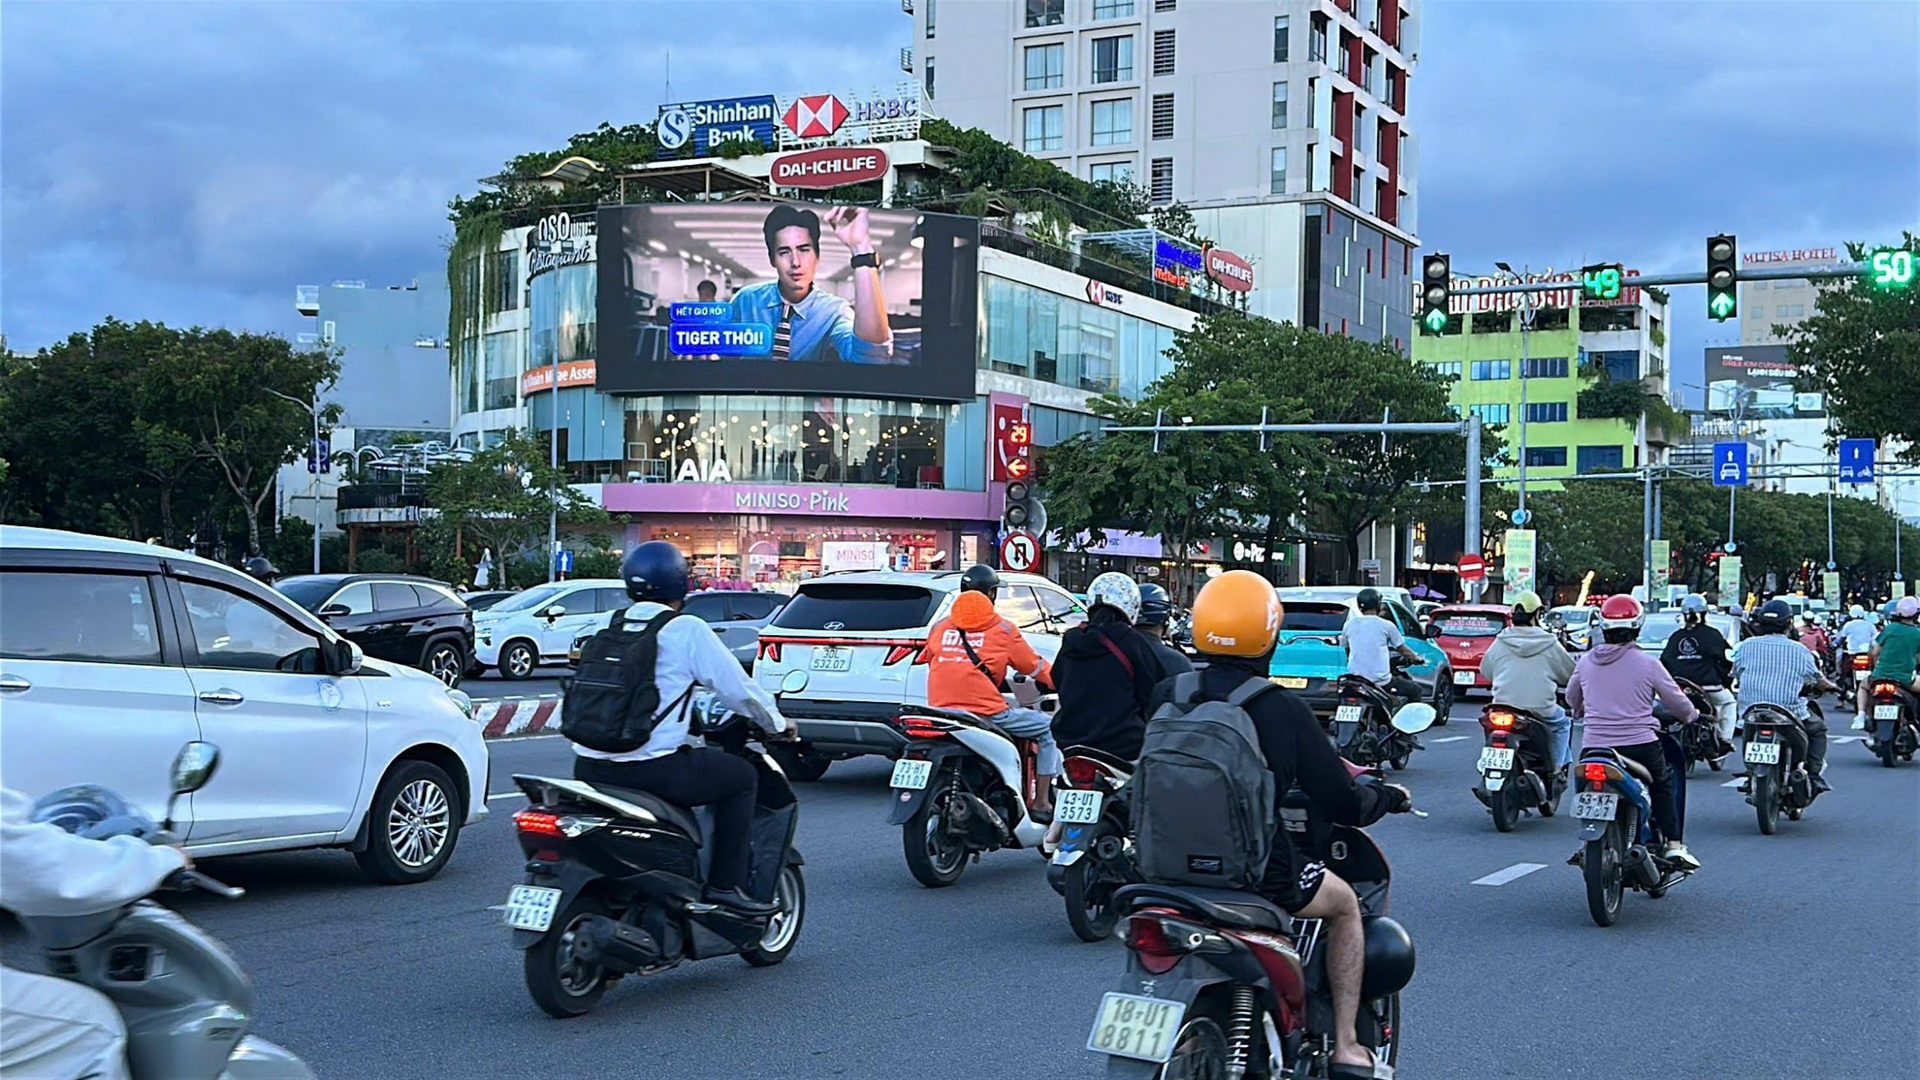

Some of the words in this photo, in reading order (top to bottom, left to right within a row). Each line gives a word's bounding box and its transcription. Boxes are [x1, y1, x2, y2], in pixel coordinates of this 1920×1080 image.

[693, 103, 771, 124] Shinhan
[854, 99, 917, 121] HSBC
[708, 128, 756, 147] Bank
[779, 159, 842, 178] DAI-ICHI
[842, 155, 877, 170] LIFE
[1742, 251, 1790, 264] MITISA
[1792, 248, 1838, 260] HOTEL
[1873, 250, 1912, 283] 50
[1584, 268, 1620, 299] 49
[676, 331, 720, 346] TIGER
[723, 328, 764, 346] THÔI!
[1011, 425, 1027, 443] 29
[677, 458, 732, 482] AIA
[736, 492, 801, 509] MINISO
[809, 489, 850, 512] Pink
[836, 549, 875, 562] MINISO
[823, 649, 840, 659] 30L
[813, 659, 846, 669] 532.07
[900, 762, 925, 775] 73-H1
[1063, 792, 1094, 806] 43-U1
[1060, 806, 1092, 821] 3573
[1112, 998, 1170, 1030] 18-U1
[1101, 1023, 1162, 1057] 8811
